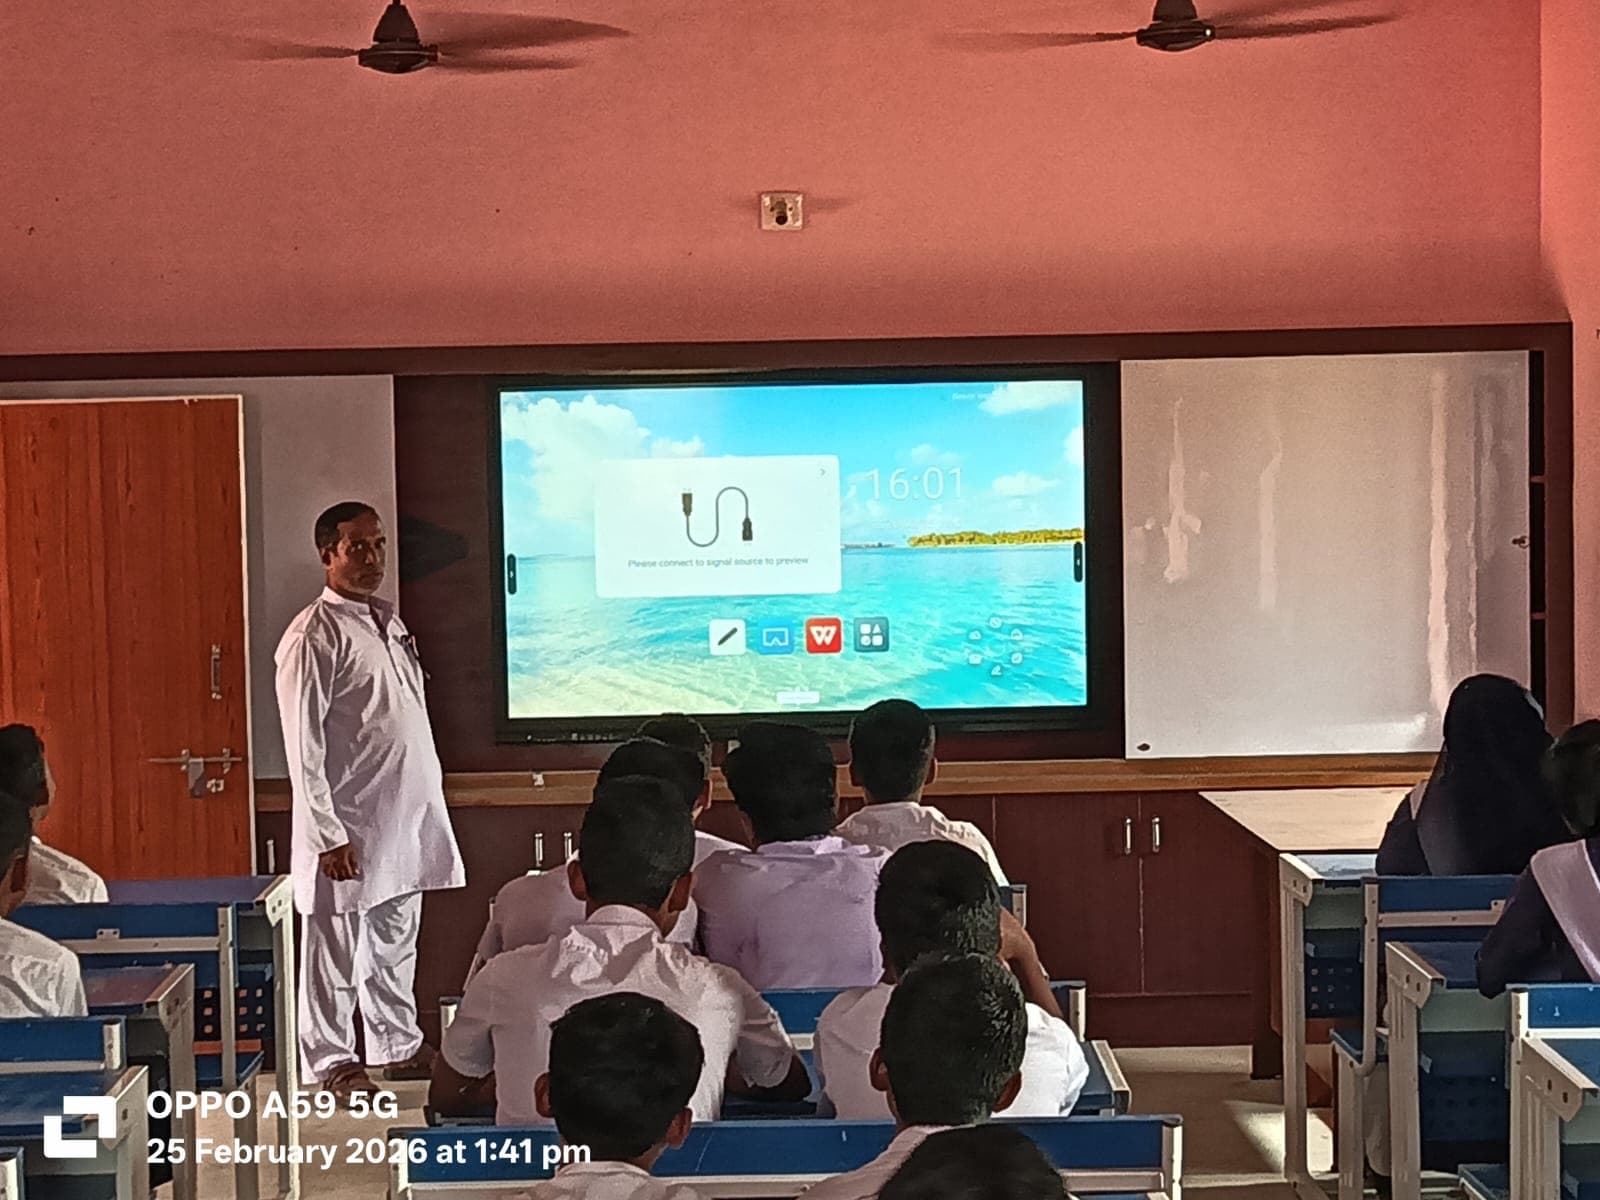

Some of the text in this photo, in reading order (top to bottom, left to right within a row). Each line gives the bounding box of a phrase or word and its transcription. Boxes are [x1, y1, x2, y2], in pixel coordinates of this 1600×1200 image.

[865, 466, 962, 500] 16:01
[627, 556, 809, 568] Please connect to signal source to preview
